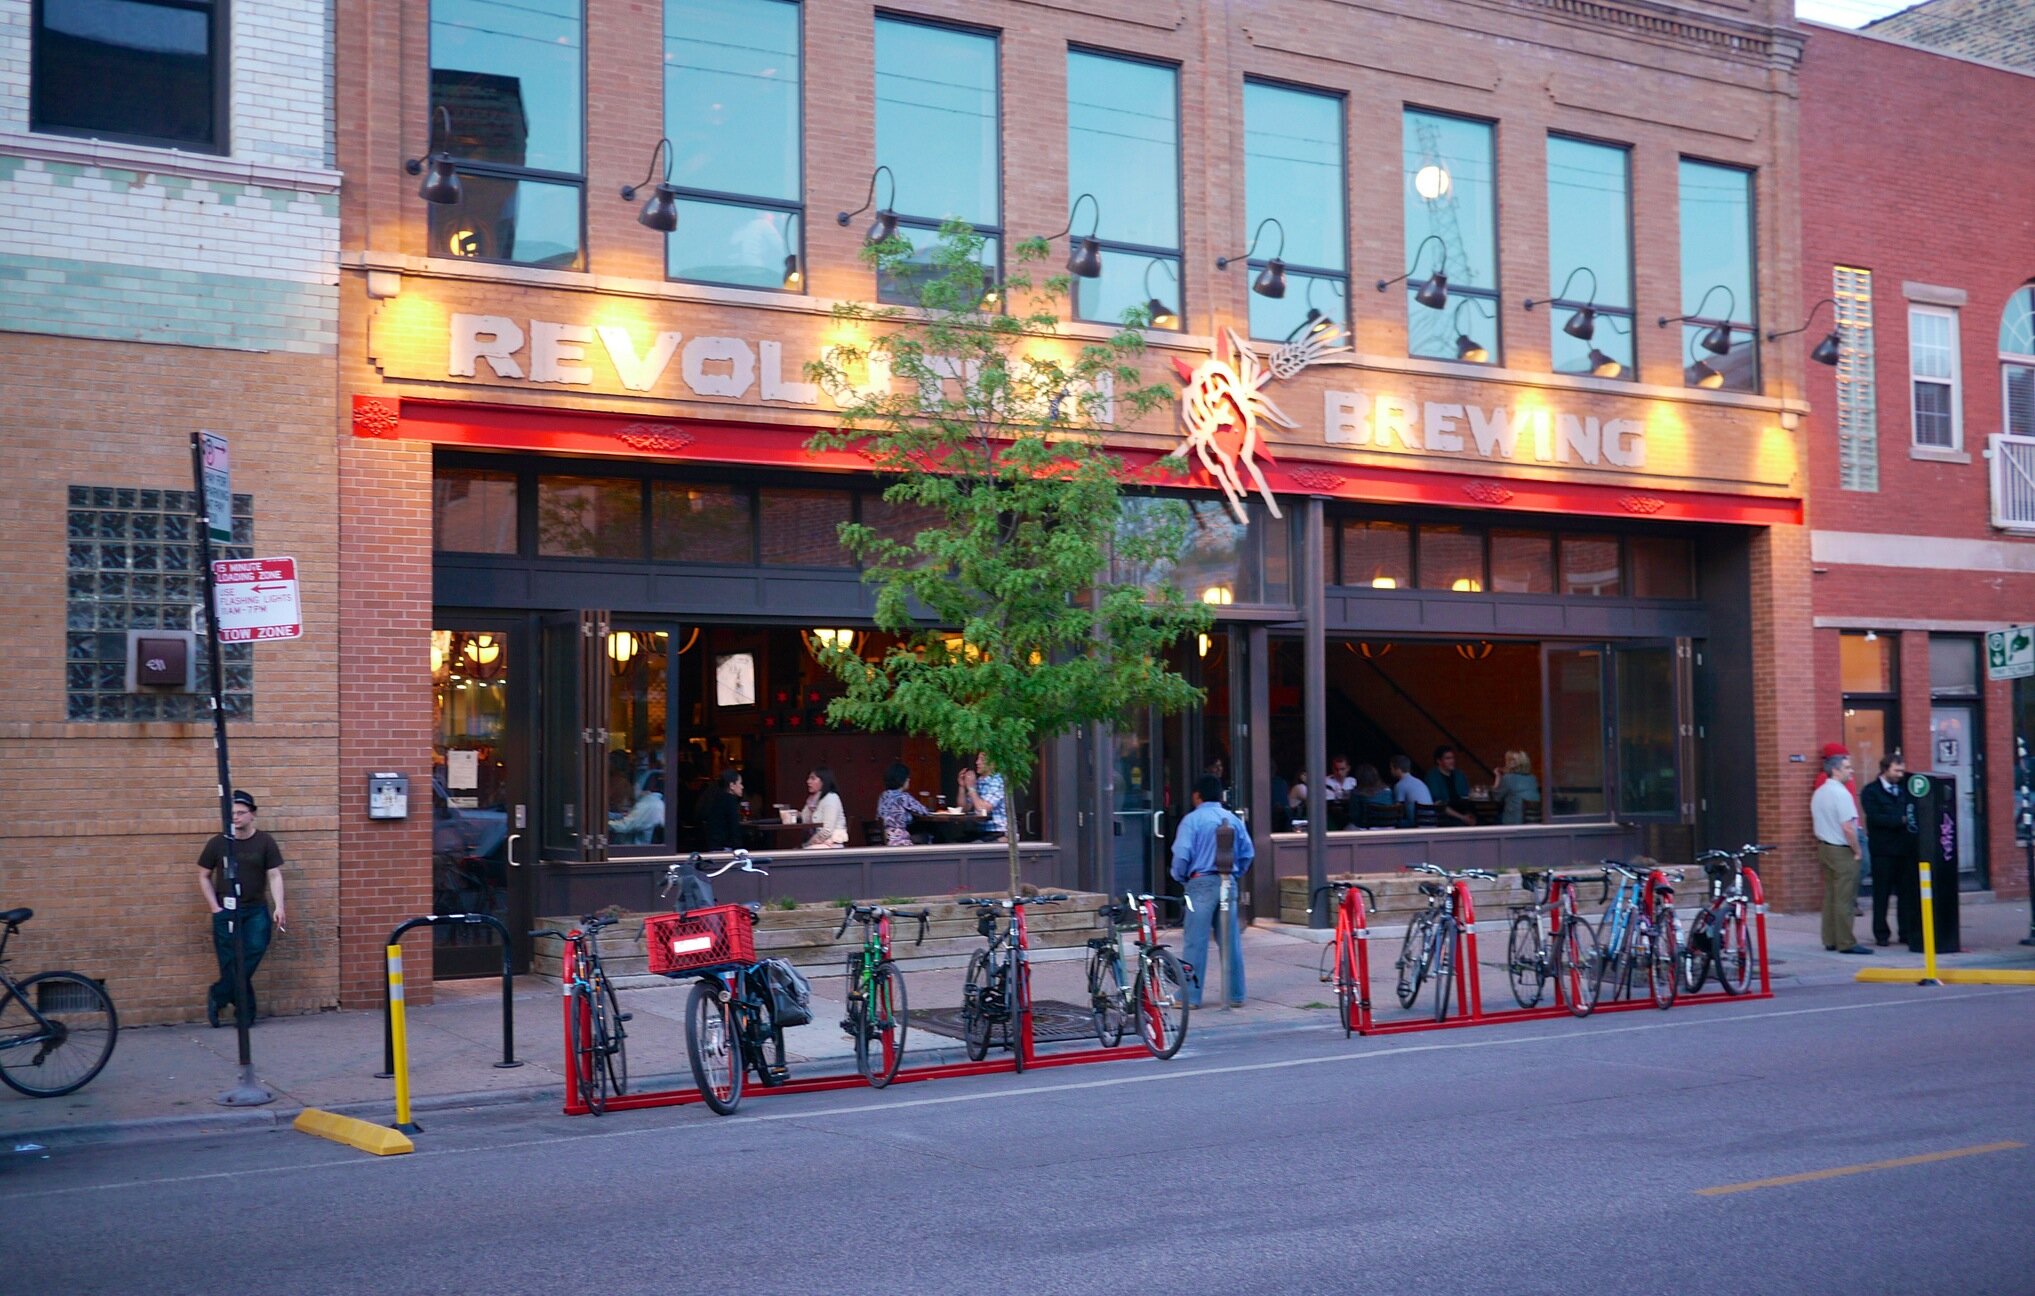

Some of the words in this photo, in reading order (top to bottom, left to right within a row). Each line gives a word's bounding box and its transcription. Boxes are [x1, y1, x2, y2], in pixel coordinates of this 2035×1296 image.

[1323, 389, 1646, 468] BREWING
[229, 562, 263, 572] MINUTE
[216, 572, 255, 583] LOADING
[258, 570, 283, 581] ZONE
[221, 587, 235, 596] USE
[221, 595, 260, 605] FLASHING
[264, 593, 292, 603] LIGHTS
[222, 628, 252, 641] TOW
[257, 625, 295, 639] ZONE
